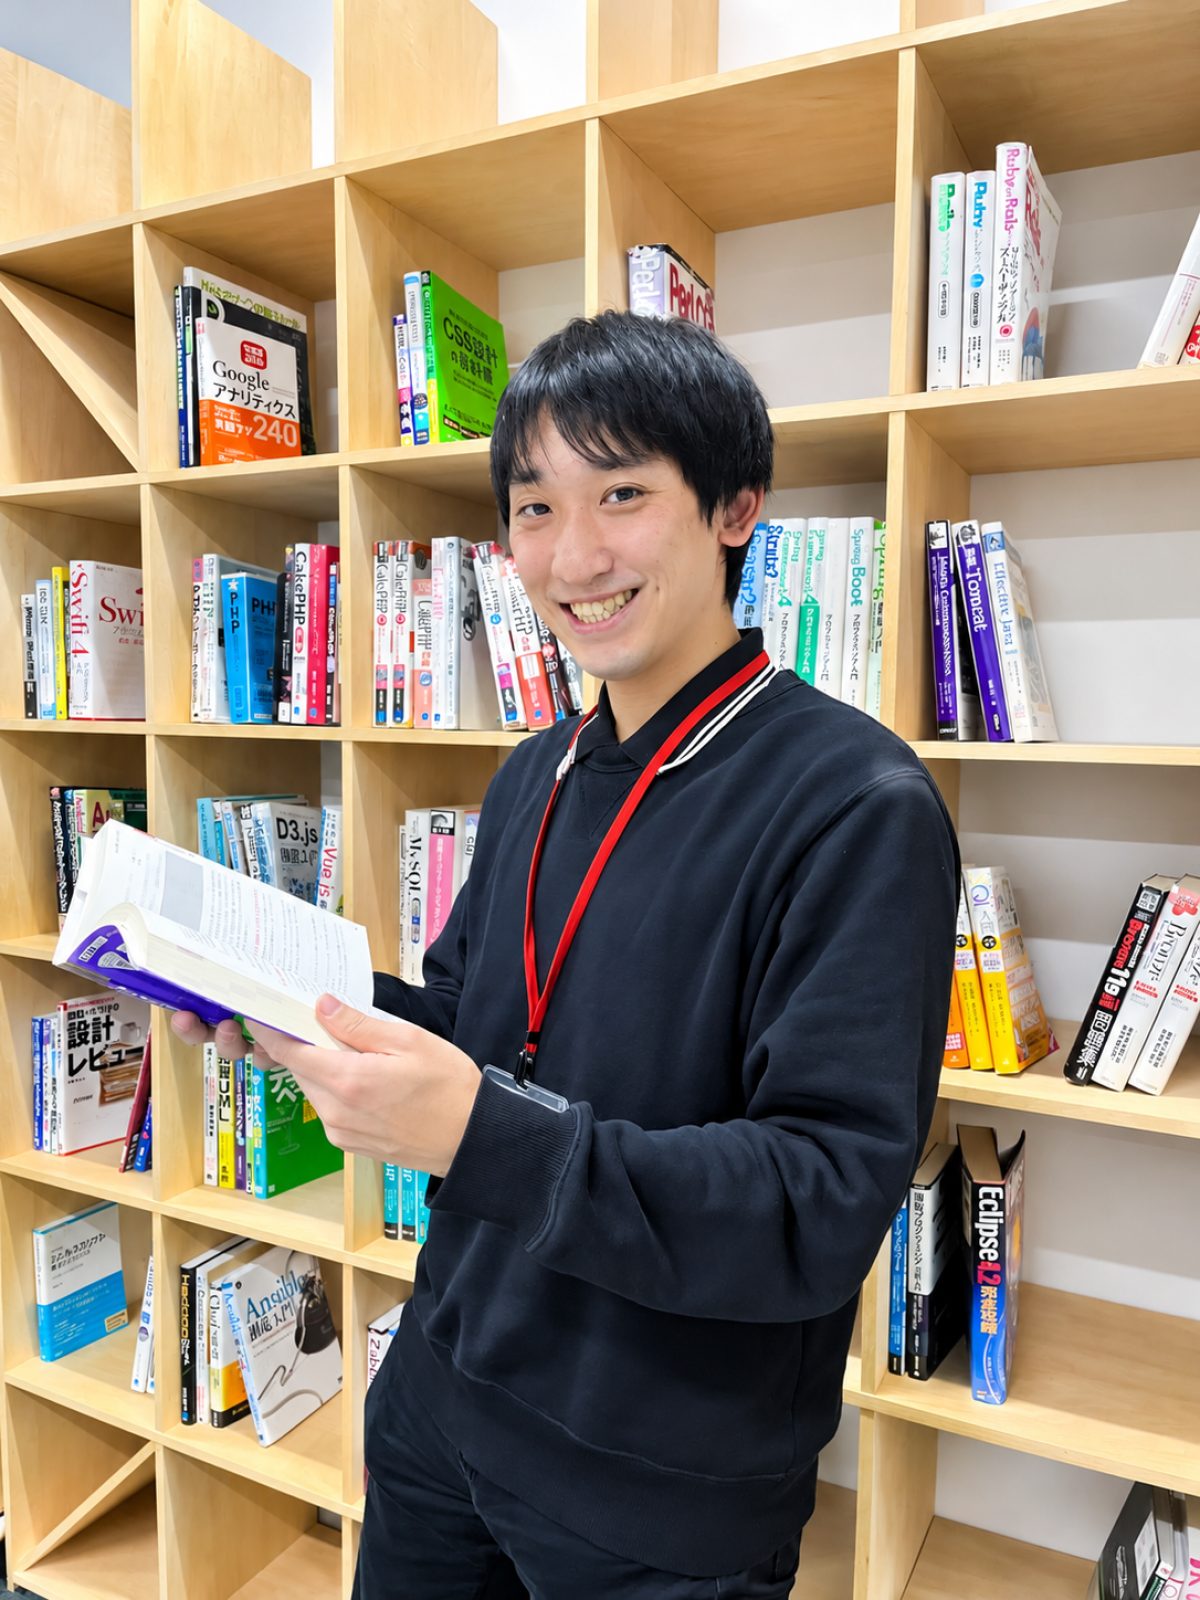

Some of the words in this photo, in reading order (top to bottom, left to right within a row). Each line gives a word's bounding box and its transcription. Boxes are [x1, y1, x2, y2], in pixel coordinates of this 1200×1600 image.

[212, 360, 270, 391] Google
[213, 382, 297, 419] アナリティクス
[252, 415, 297, 447] 240
[295, 550, 308, 626] CakePHP
[275, 816, 319, 847] D3.js
[67, 1014, 114, 1050] 設計
[68, 1045, 145, 1078] レビュー
[978, 1185, 1005, 1262] Eclipse
